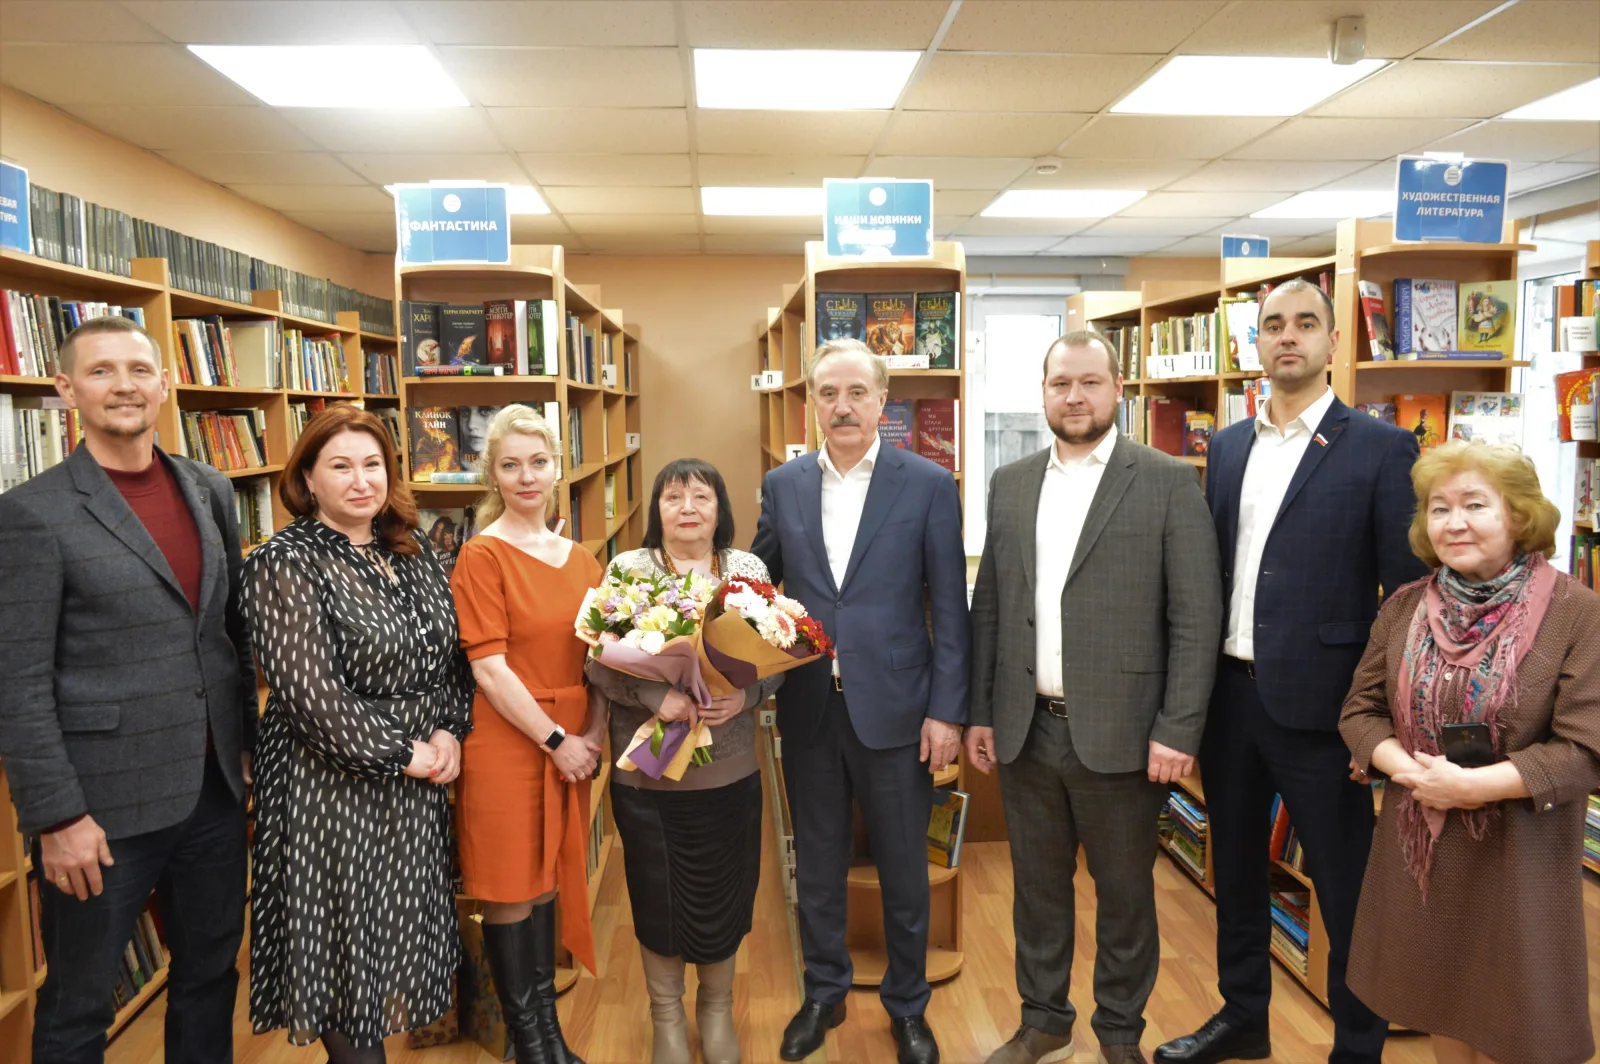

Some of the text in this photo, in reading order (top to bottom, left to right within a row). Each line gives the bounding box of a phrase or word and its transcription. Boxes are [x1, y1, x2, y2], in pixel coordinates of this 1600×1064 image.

[1402, 191, 1501, 204] ХУДОЖЕСТВЕННАЯ
[1416, 206, 1484, 218] ЛИТЕРАТУРА
[409, 220, 498, 231] ФАНТАСТИКА
[834, 215, 922, 225] НАШИ НОВИНКИ
[1164, 359, 1174, 371] Ч
[768, 375, 773, 384] П
[415, 411, 452, 420] КЛИНОК
